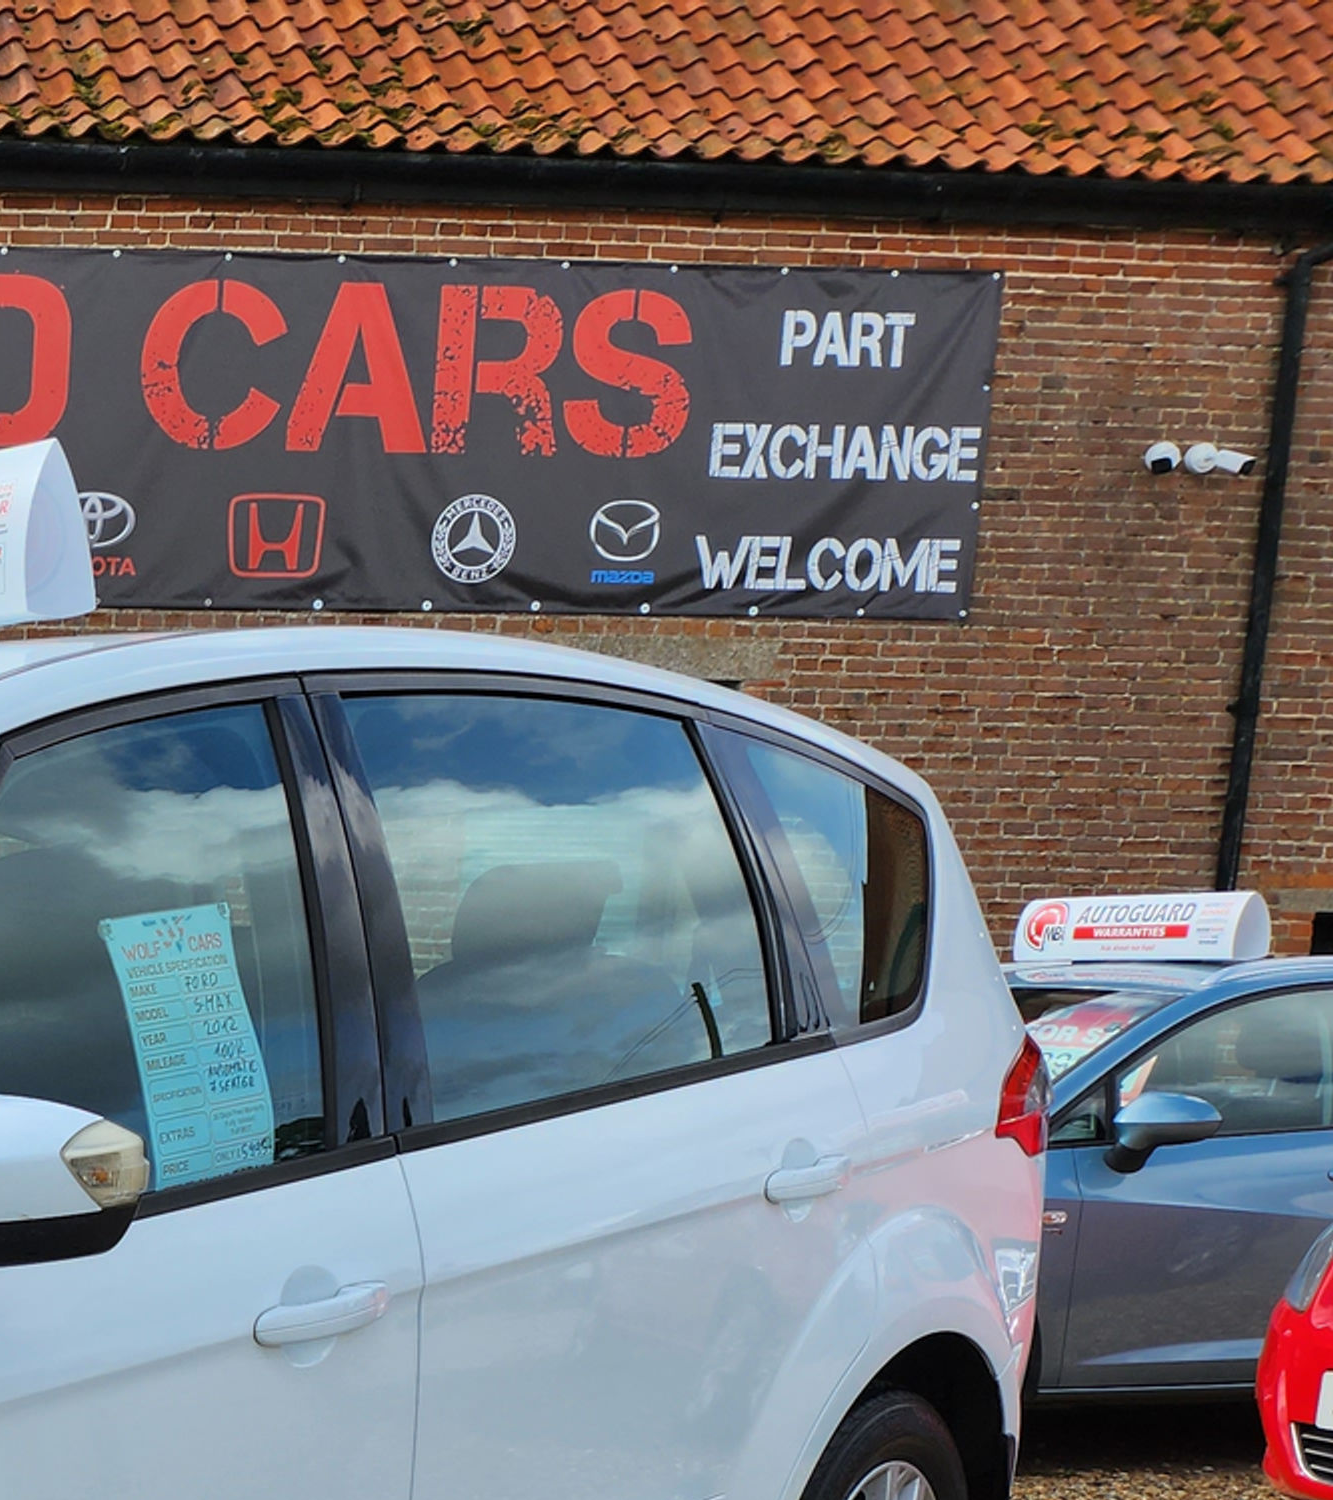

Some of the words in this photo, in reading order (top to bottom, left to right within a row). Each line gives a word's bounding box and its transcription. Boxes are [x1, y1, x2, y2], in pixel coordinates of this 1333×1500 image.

[779, 308, 917, 369] PART
[140, 278, 694, 459] CARS
[708, 421, 982, 482] EXCHANGE
[446, 497, 508, 526] MERCEDES
[92, 555, 137, 577] OTA
[450, 564, 489, 580] BENZ
[694, 533, 963, 594] WELCOME
[1076, 902, 1198, 924] AUTOGUARD
[1092, 926, 1166, 938] WARRANTIES
[121, 940, 161, 961] WOLF
[187, 931, 223, 953] CARS
[125, 962, 165, 980] VEHICLE
[165, 954, 229, 973] SPECIFICATION
[129, 982, 158, 997] MAKE
[184, 972, 219, 993] FORD
[134, 1006, 170, 1021] MODEL
[140, 1031, 167, 1048] YEAR
[202, 1015, 238, 1036] 2012
[145, 1053, 188, 1071] MILEAGE
[158, 1126, 197, 1145] EXTRAS
[162, 1159, 190, 1177] PRICE
